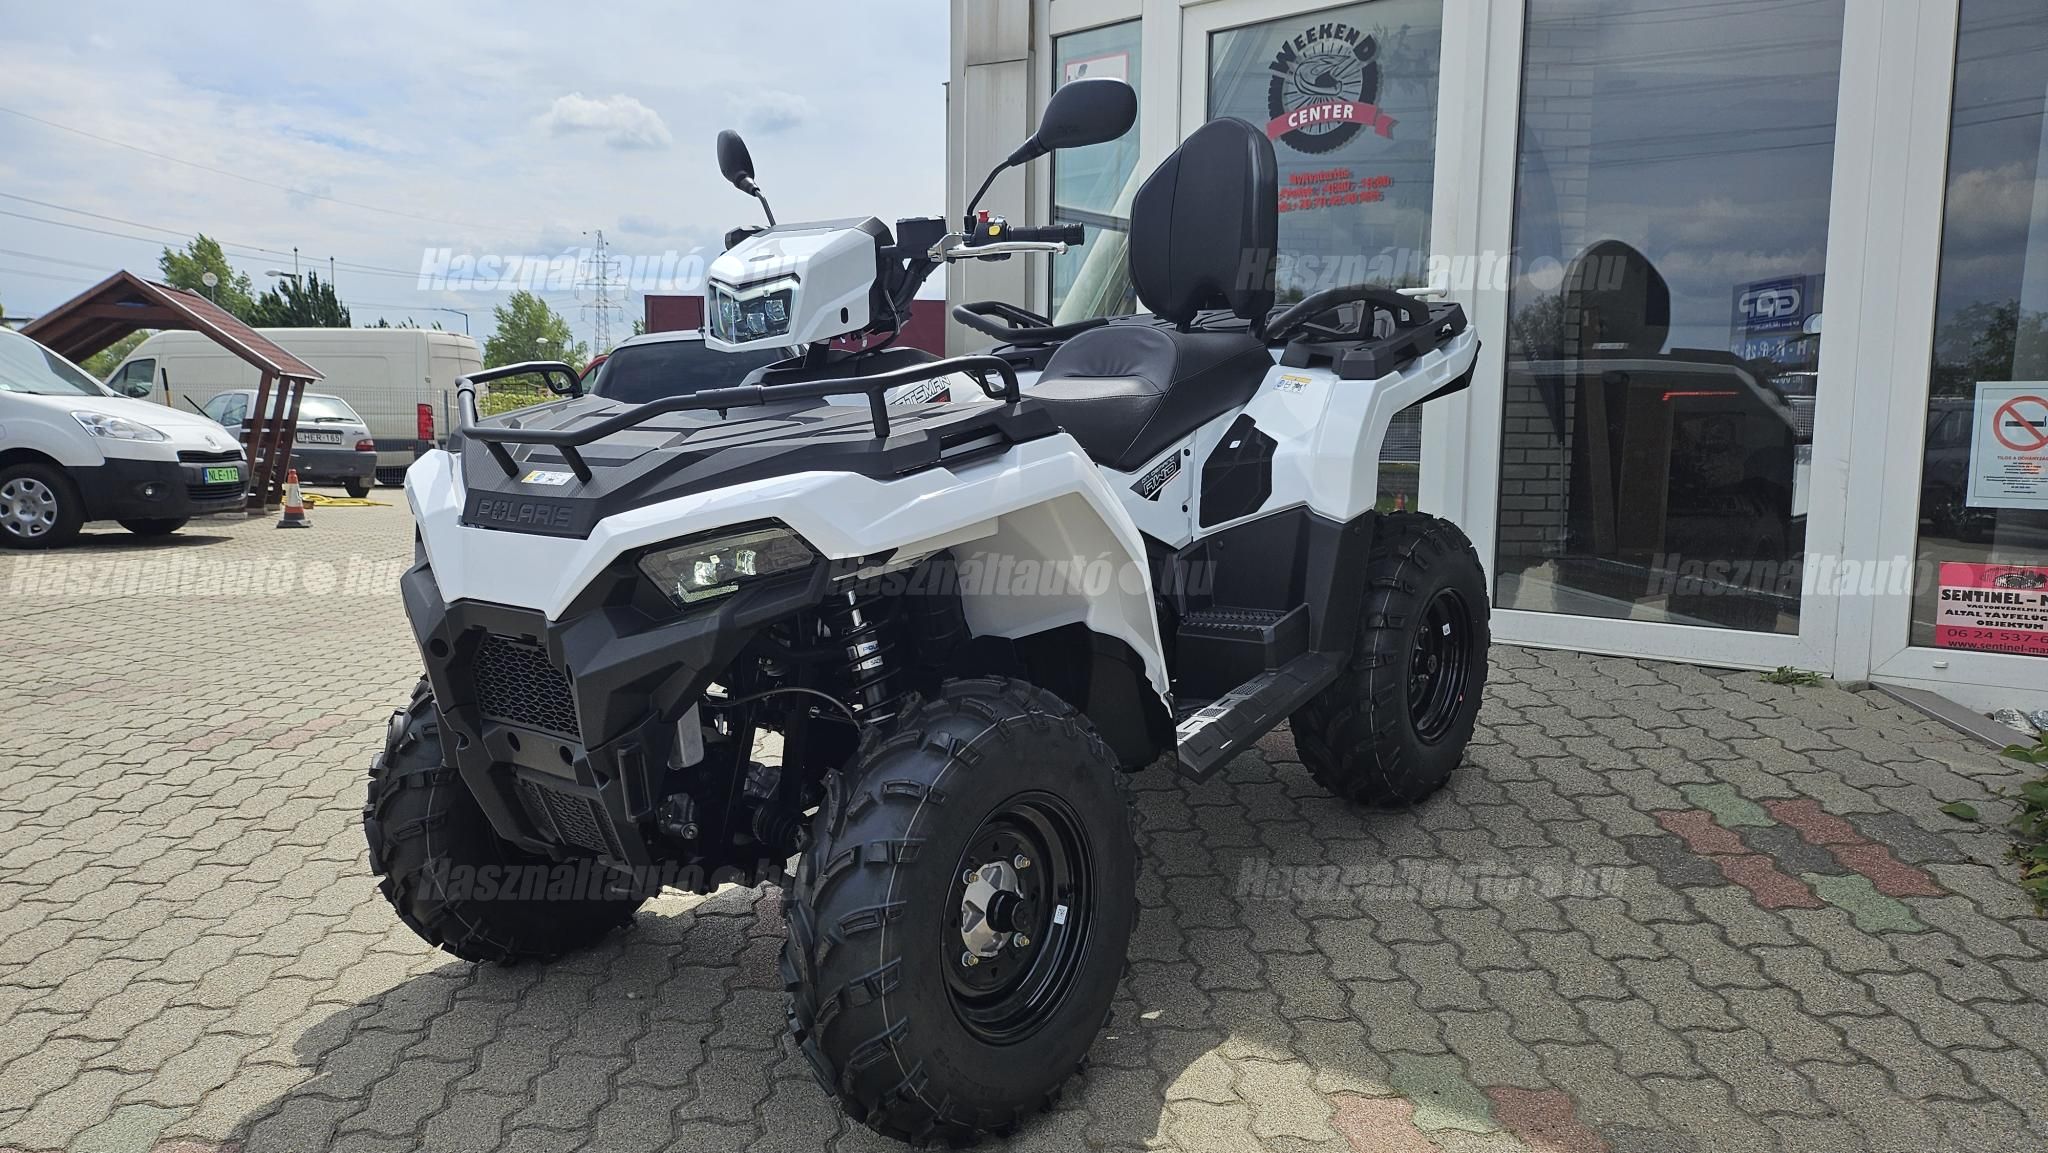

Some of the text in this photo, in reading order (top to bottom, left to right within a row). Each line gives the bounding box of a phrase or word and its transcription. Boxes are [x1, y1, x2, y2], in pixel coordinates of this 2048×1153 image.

[1269, 23, 1376, 73] WEEKEND
[1288, 104, 1353, 127] CENTER
[208, 468, 238, 481] NLE-112
[1143, 461, 1177, 496] AWD
[476, 499, 573, 527] POLARIS
[1941, 589, 2024, 605] SENTINEL
[1945, 609, 1983, 618] ÁLTAL
[1976, 619, 2044, 630] OBJEKTUM
[1947, 628, 1968, 638] 06
[1973, 631, 1993, 639] 24
[1948, 640, 2048, 655] www.sentinel-ma
